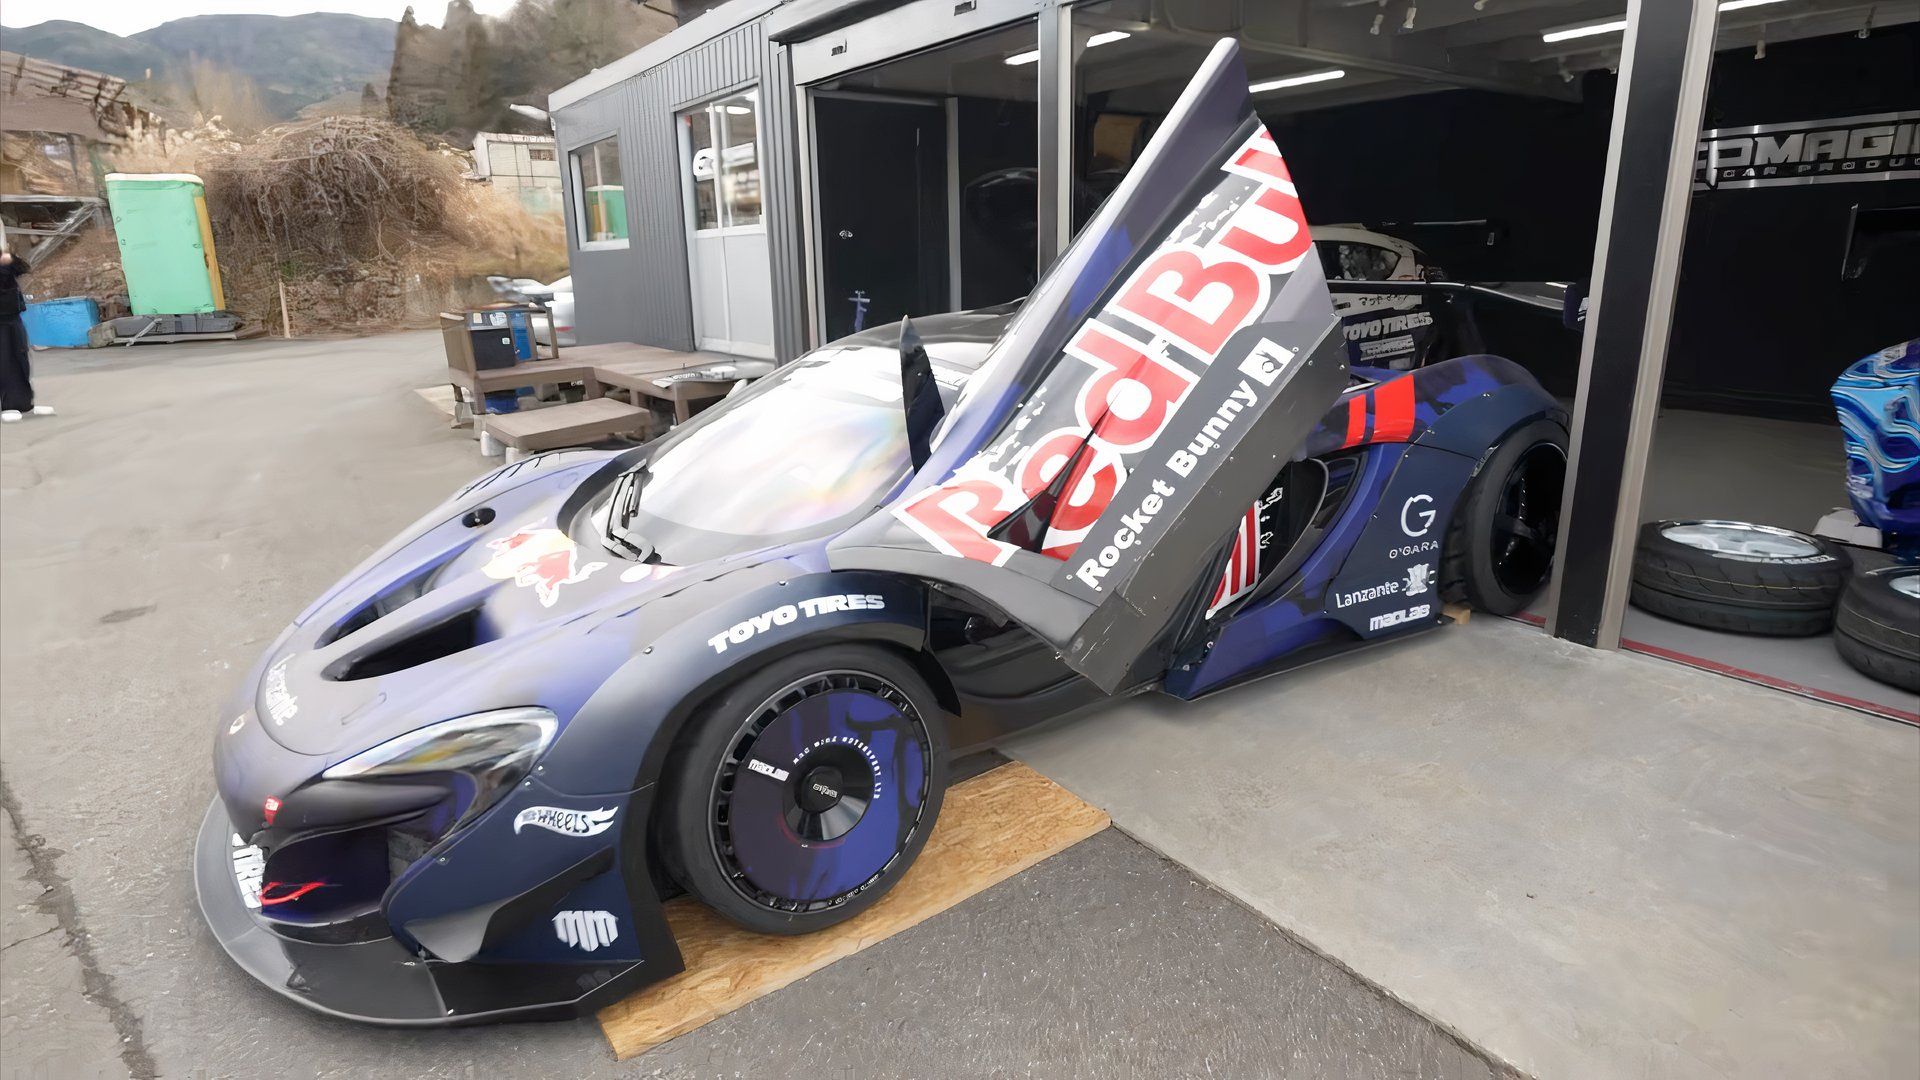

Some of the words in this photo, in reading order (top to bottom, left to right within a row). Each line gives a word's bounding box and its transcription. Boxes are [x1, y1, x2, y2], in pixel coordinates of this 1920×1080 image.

[1381, 312, 1433, 334] TIRES
[1076, 479, 1176, 591] Rocket
[1165, 379, 1258, 479] Bunny
[1389, 540, 1439, 559] O'GARA
[1335, 581, 1399, 608] Lanzante
[707, 604, 798, 654] TOYO
[797, 594, 886, 618] TIRES
